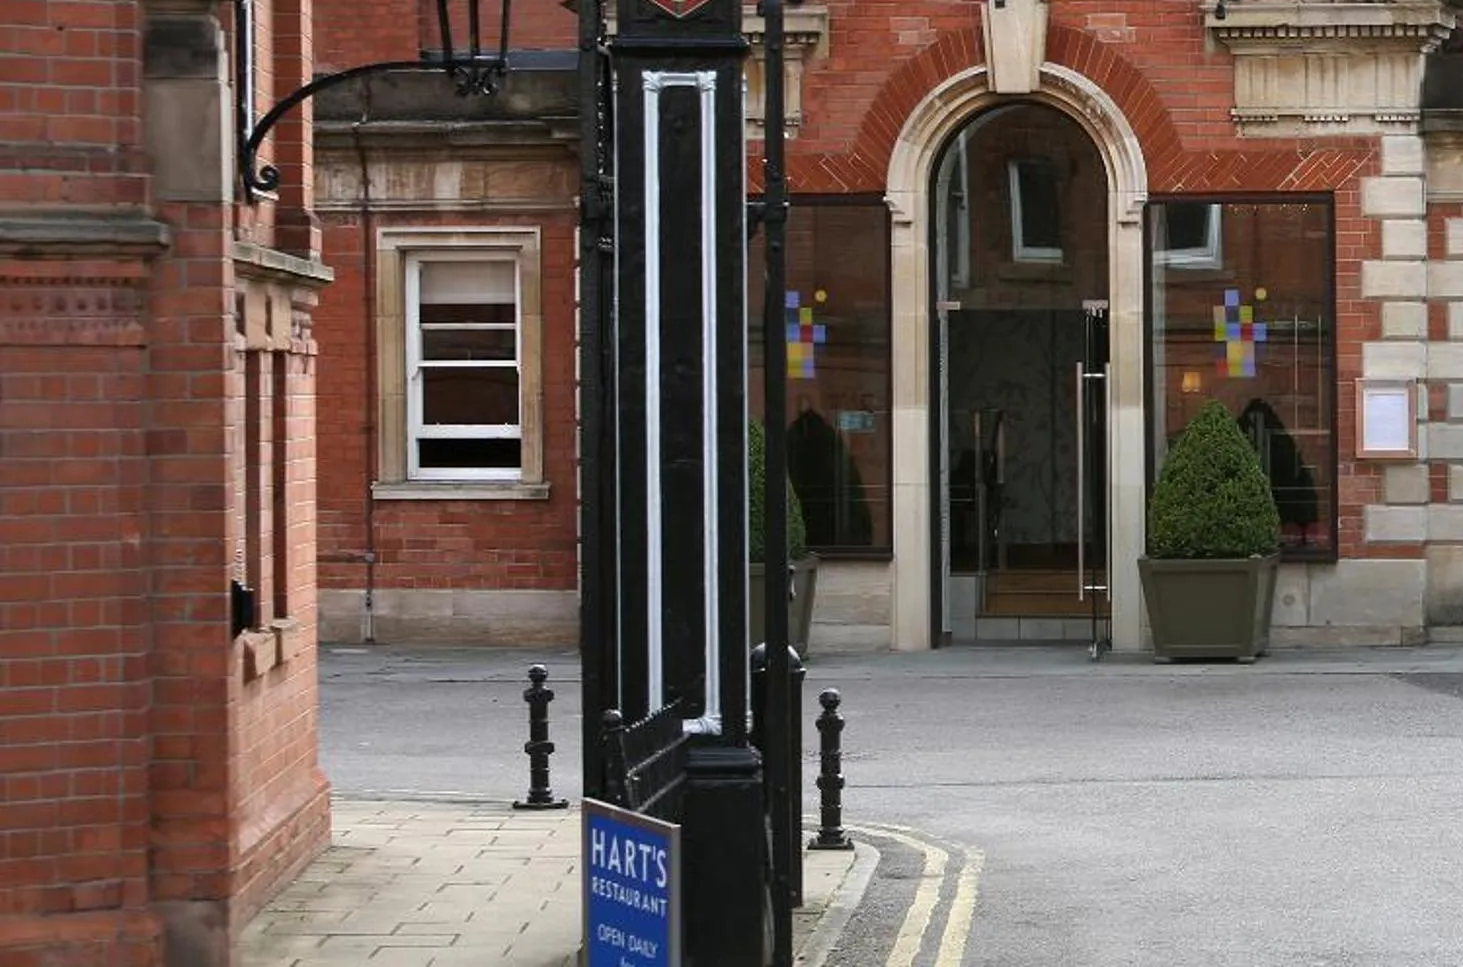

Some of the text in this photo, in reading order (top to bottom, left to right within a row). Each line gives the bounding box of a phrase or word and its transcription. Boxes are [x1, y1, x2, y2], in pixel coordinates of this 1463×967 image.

[592, 828, 667, 888] HART'S
[592, 877, 668, 917] RESTAURANT
[598, 924, 659, 958] OPEN DAILY
